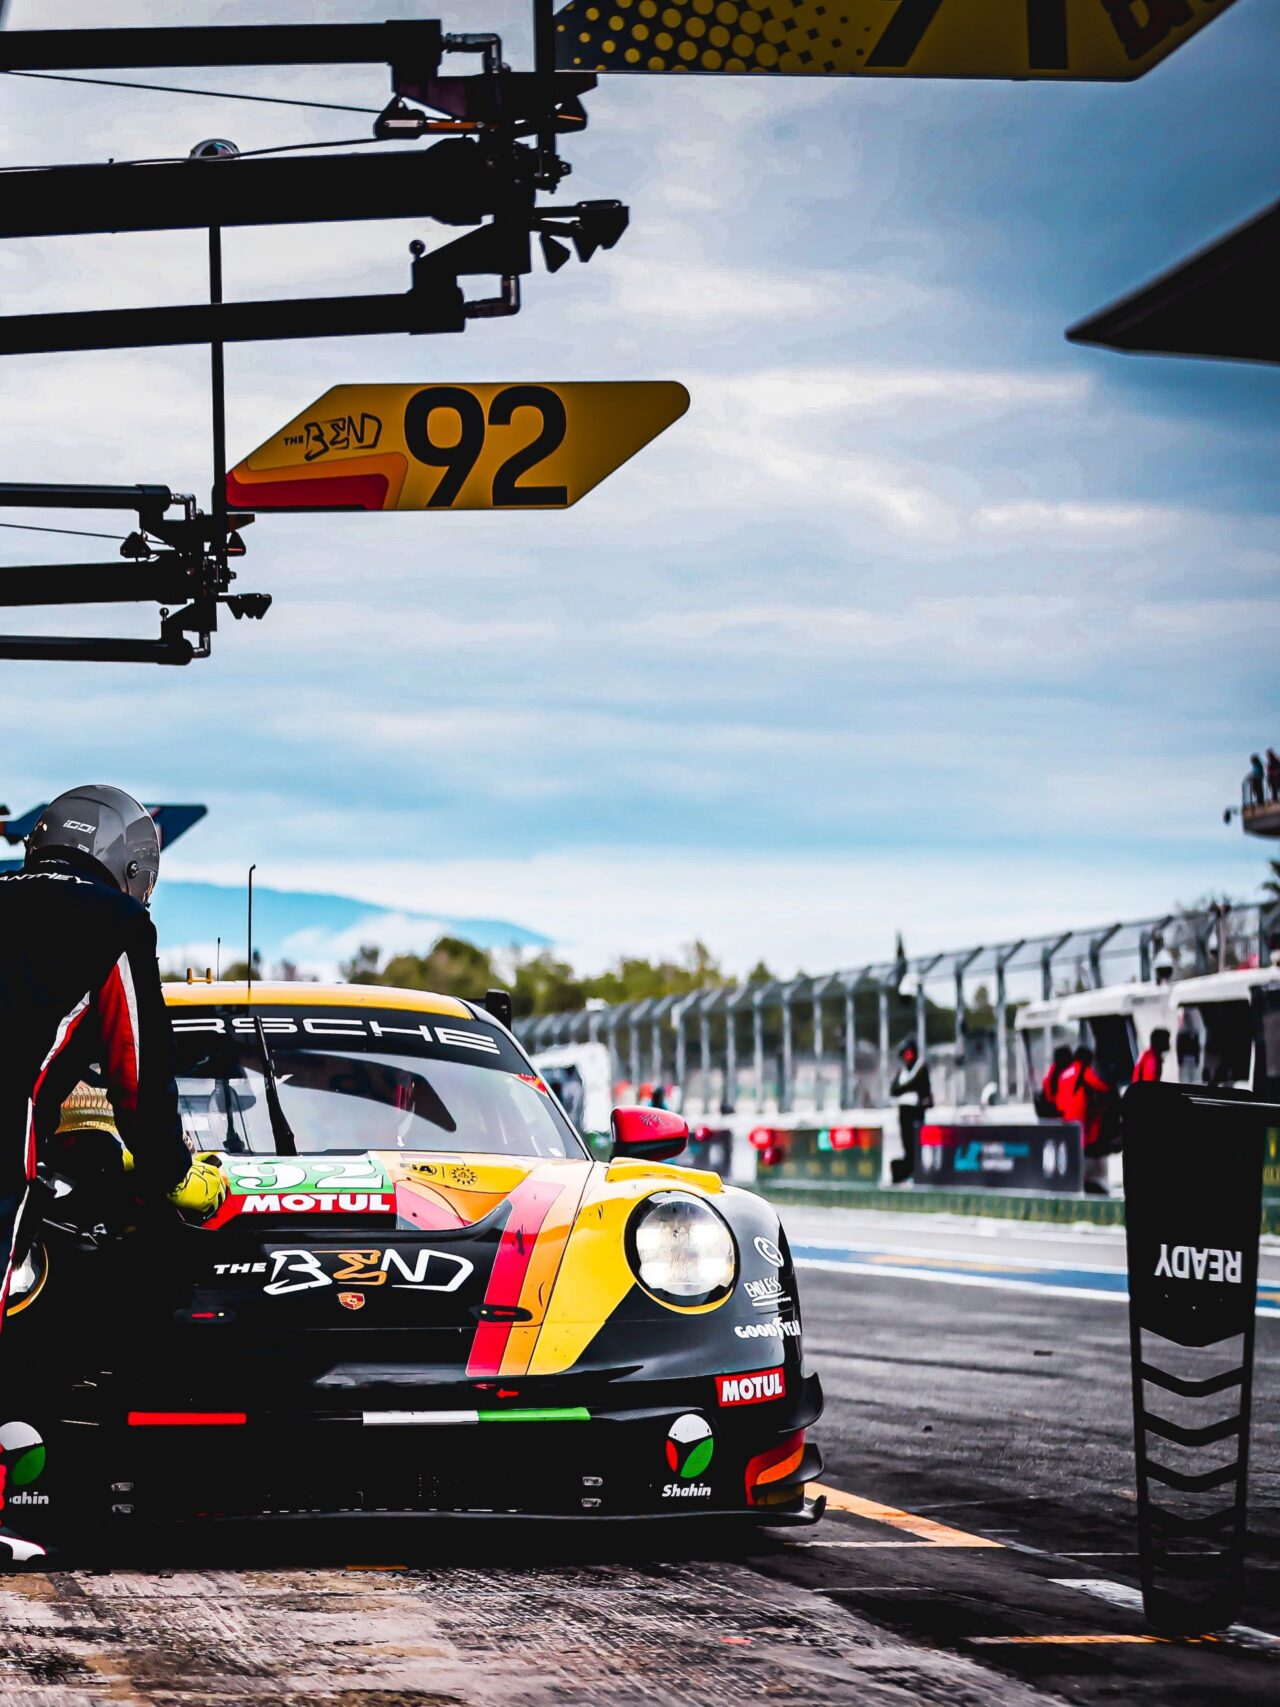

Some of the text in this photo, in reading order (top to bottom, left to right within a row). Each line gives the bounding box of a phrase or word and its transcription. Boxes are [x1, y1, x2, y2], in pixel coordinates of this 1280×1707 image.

[404, 386, 568, 508] 92
[171, 1017, 501, 1055] RSCHE
[230, 1160, 383, 1190] 92
[241, 1194, 391, 1213] MOTUL
[214, 1248, 475, 1296] THE BEND
[1154, 1243, 1243, 1284] READY
[743, 1275, 782, 1298] ENDLESS
[722, 1373, 783, 1402] MOTUL
[9, 1491, 50, 1505] ahin
[661, 1482, 712, 1498] Shahin
